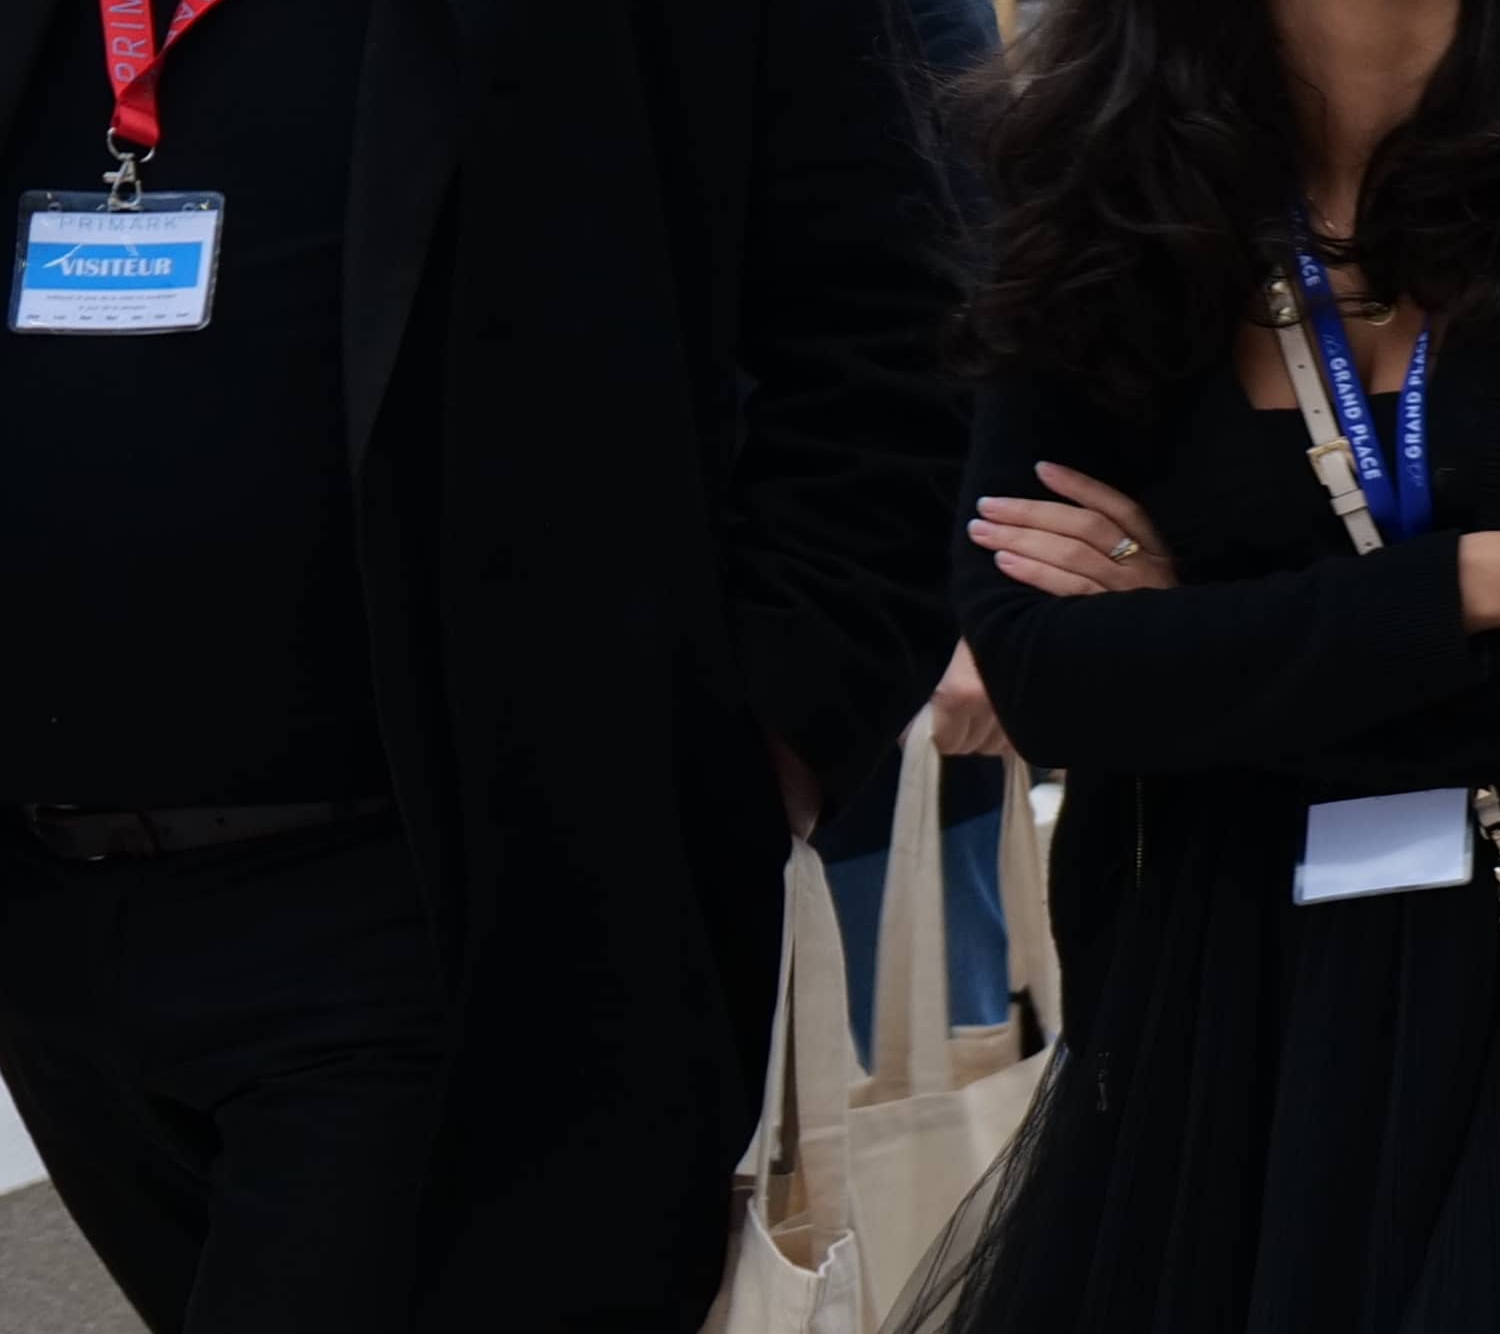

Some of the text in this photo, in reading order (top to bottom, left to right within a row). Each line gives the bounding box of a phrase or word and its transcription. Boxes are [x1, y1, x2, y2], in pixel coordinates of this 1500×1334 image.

[61, 257, 173, 276] VISITEUR
[1329, 356, 1383, 481] GRAND PLACE
[1404, 391, 1423, 459] GRAND
